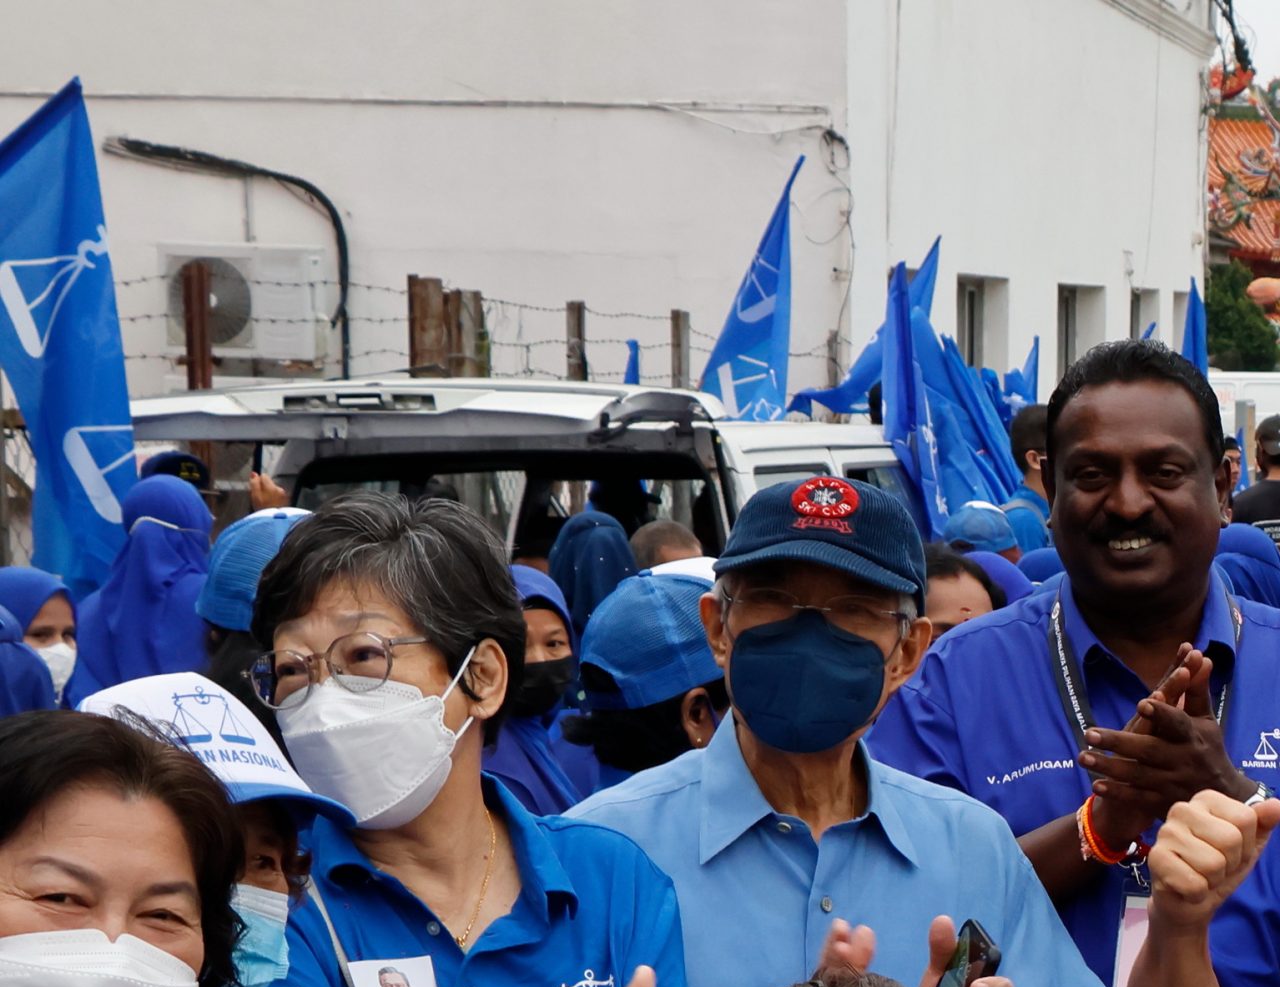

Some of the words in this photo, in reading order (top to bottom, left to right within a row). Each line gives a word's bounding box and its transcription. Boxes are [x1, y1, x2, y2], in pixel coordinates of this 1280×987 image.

[798, 501, 817, 513] SKI
[822, 503, 852, 516] CLUB
[1062, 665, 1075, 696] PILIHAN
[1071, 695, 1081, 713] RAYA
[219, 749, 286, 773] NASIONAL
[986, 775, 1001, 785] V.
[1002, 759, 1074, 784] ARUMUGAM
[1241, 760, 1277, 769] BARISAN
